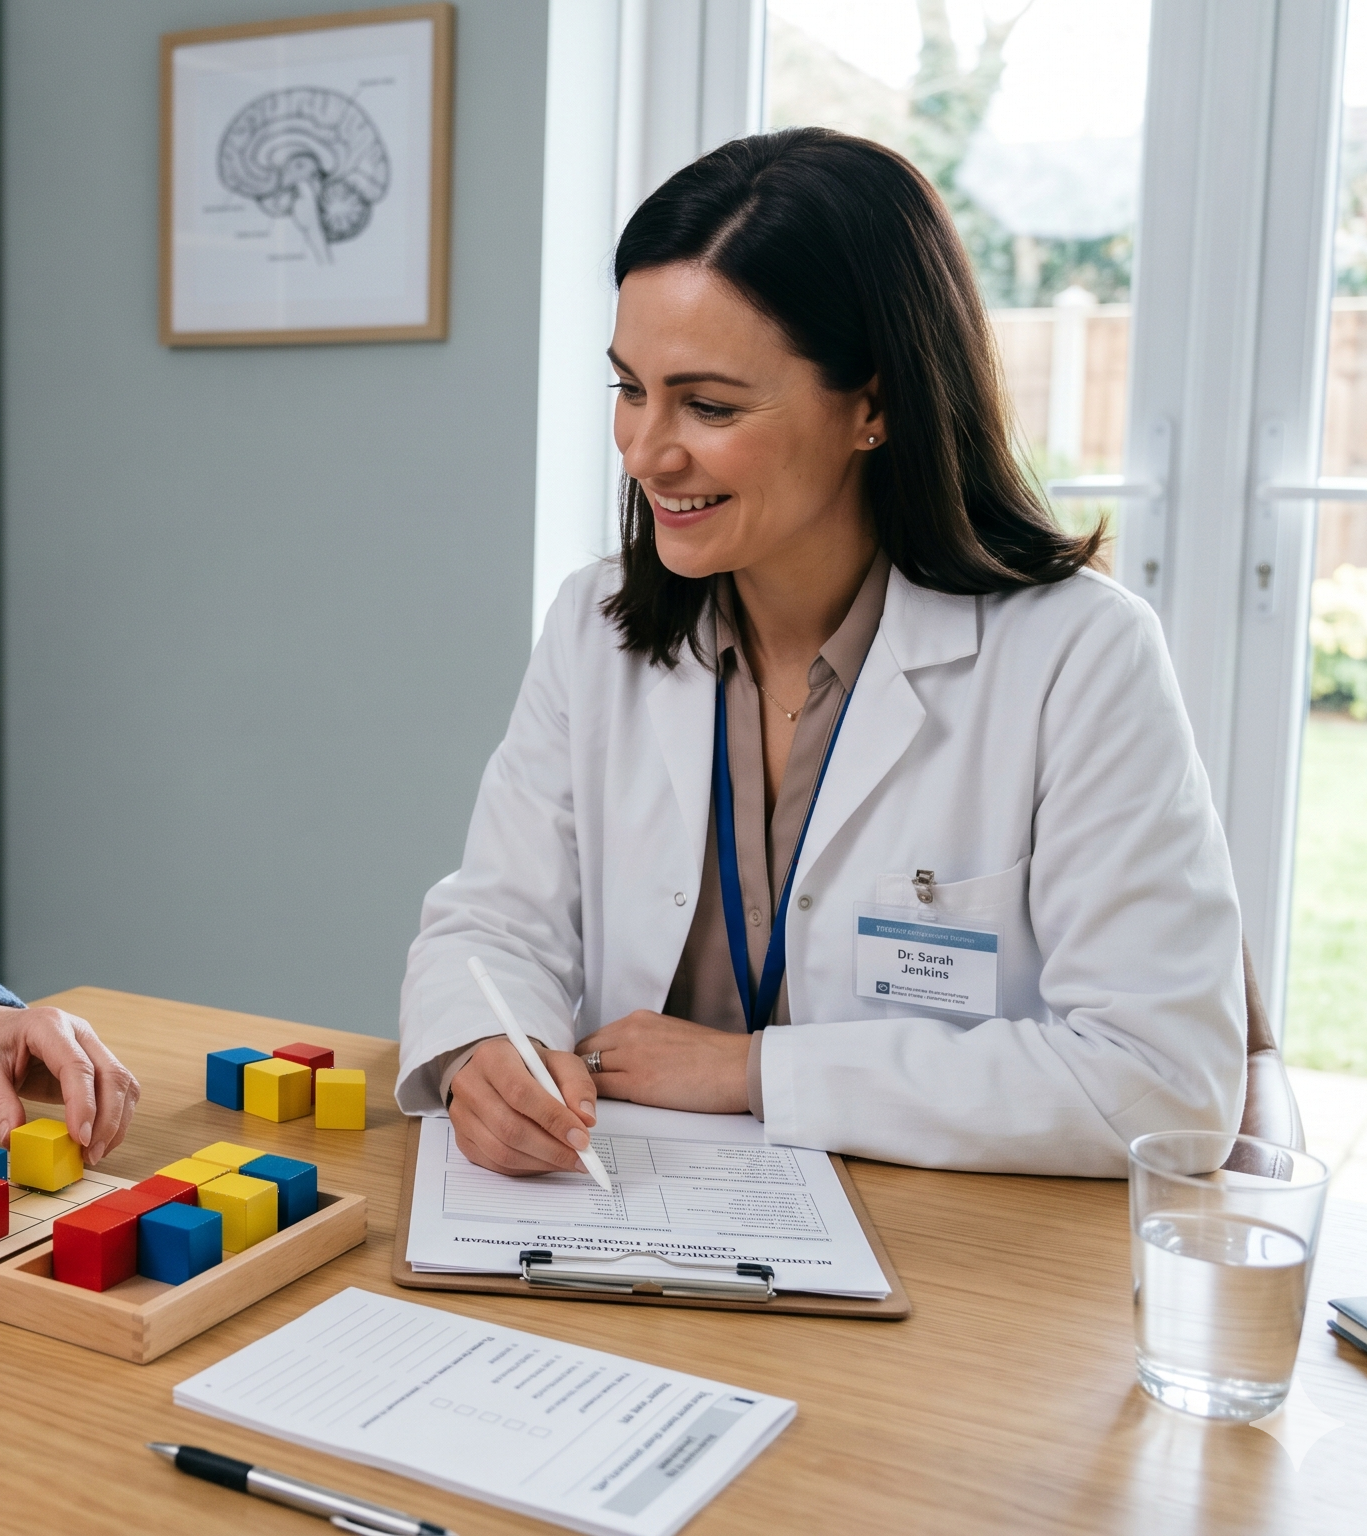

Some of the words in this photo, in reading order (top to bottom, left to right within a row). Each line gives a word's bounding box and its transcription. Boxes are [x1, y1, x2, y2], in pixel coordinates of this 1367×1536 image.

[897, 949, 914, 961] Dr.
[918, 952, 954, 966] Sarah
[901, 964, 950, 980] Jenkins
